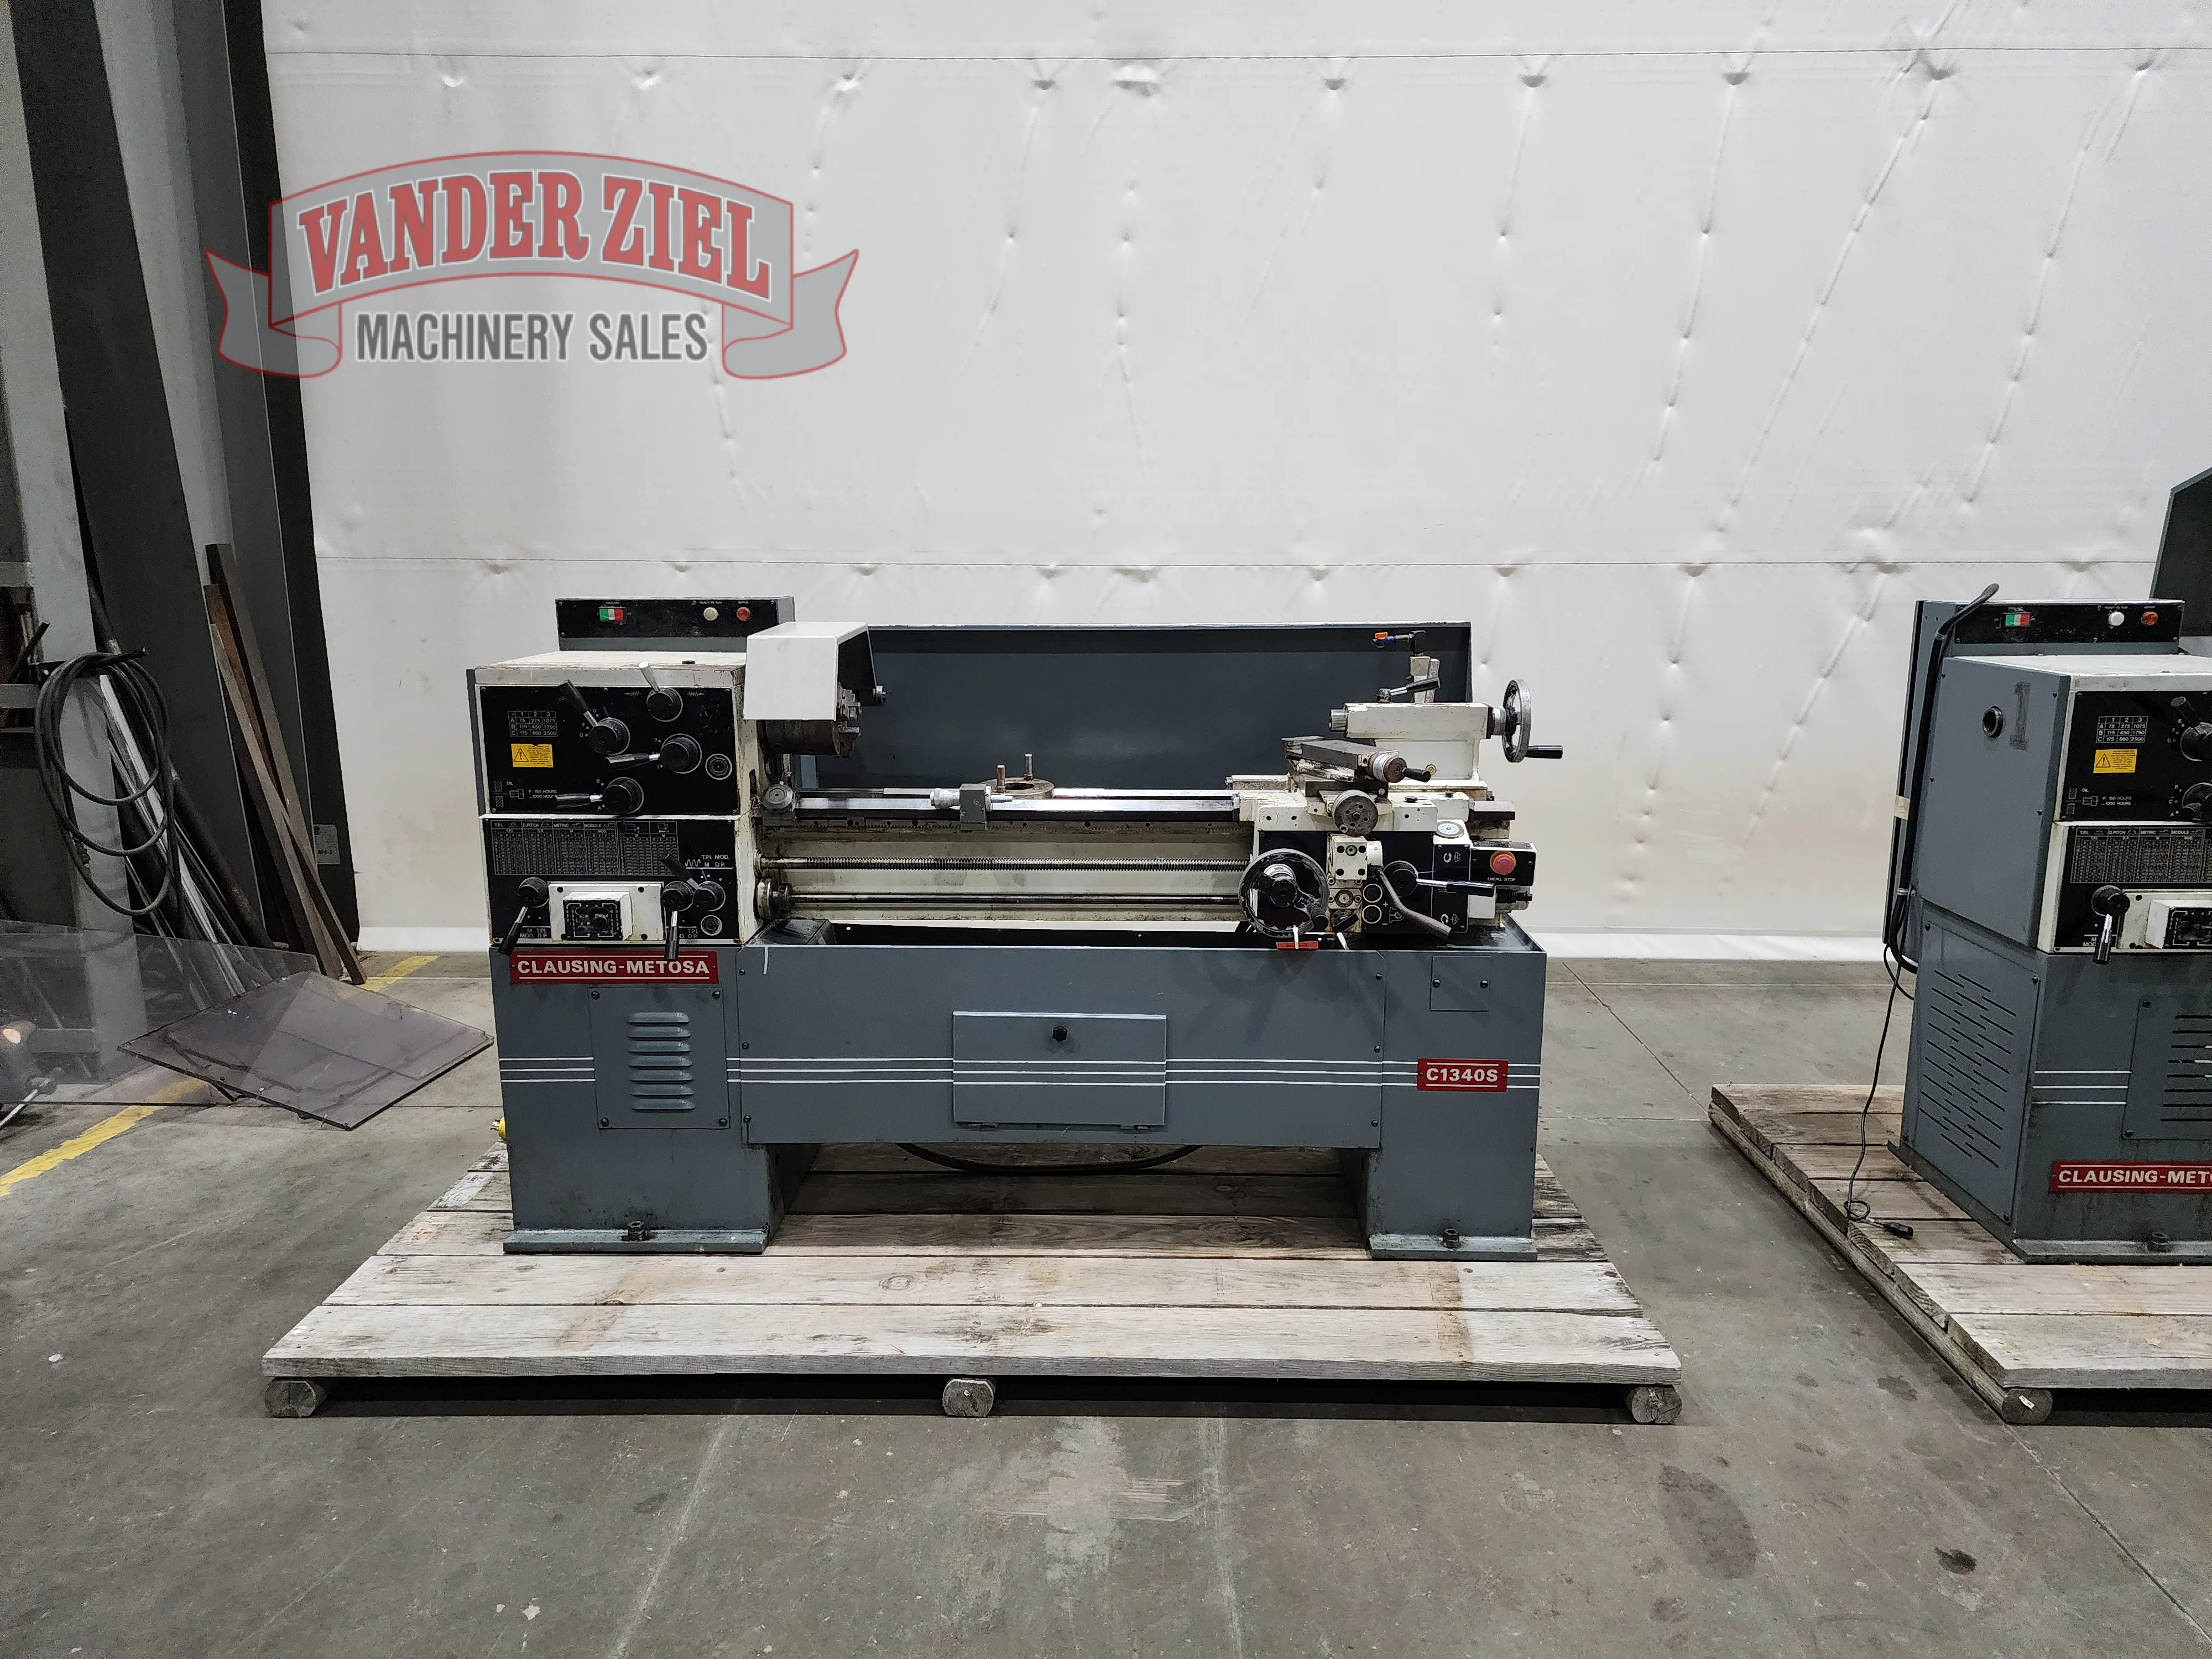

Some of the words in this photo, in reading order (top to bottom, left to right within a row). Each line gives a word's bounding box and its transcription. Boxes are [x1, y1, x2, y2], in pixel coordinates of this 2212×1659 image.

[518, 960, 710, 974] CLAUSING-METOSA
[1426, 1067, 1499, 1082] C1340S
[2058, 1170, 2212, 1184] CLAUSING-MET
